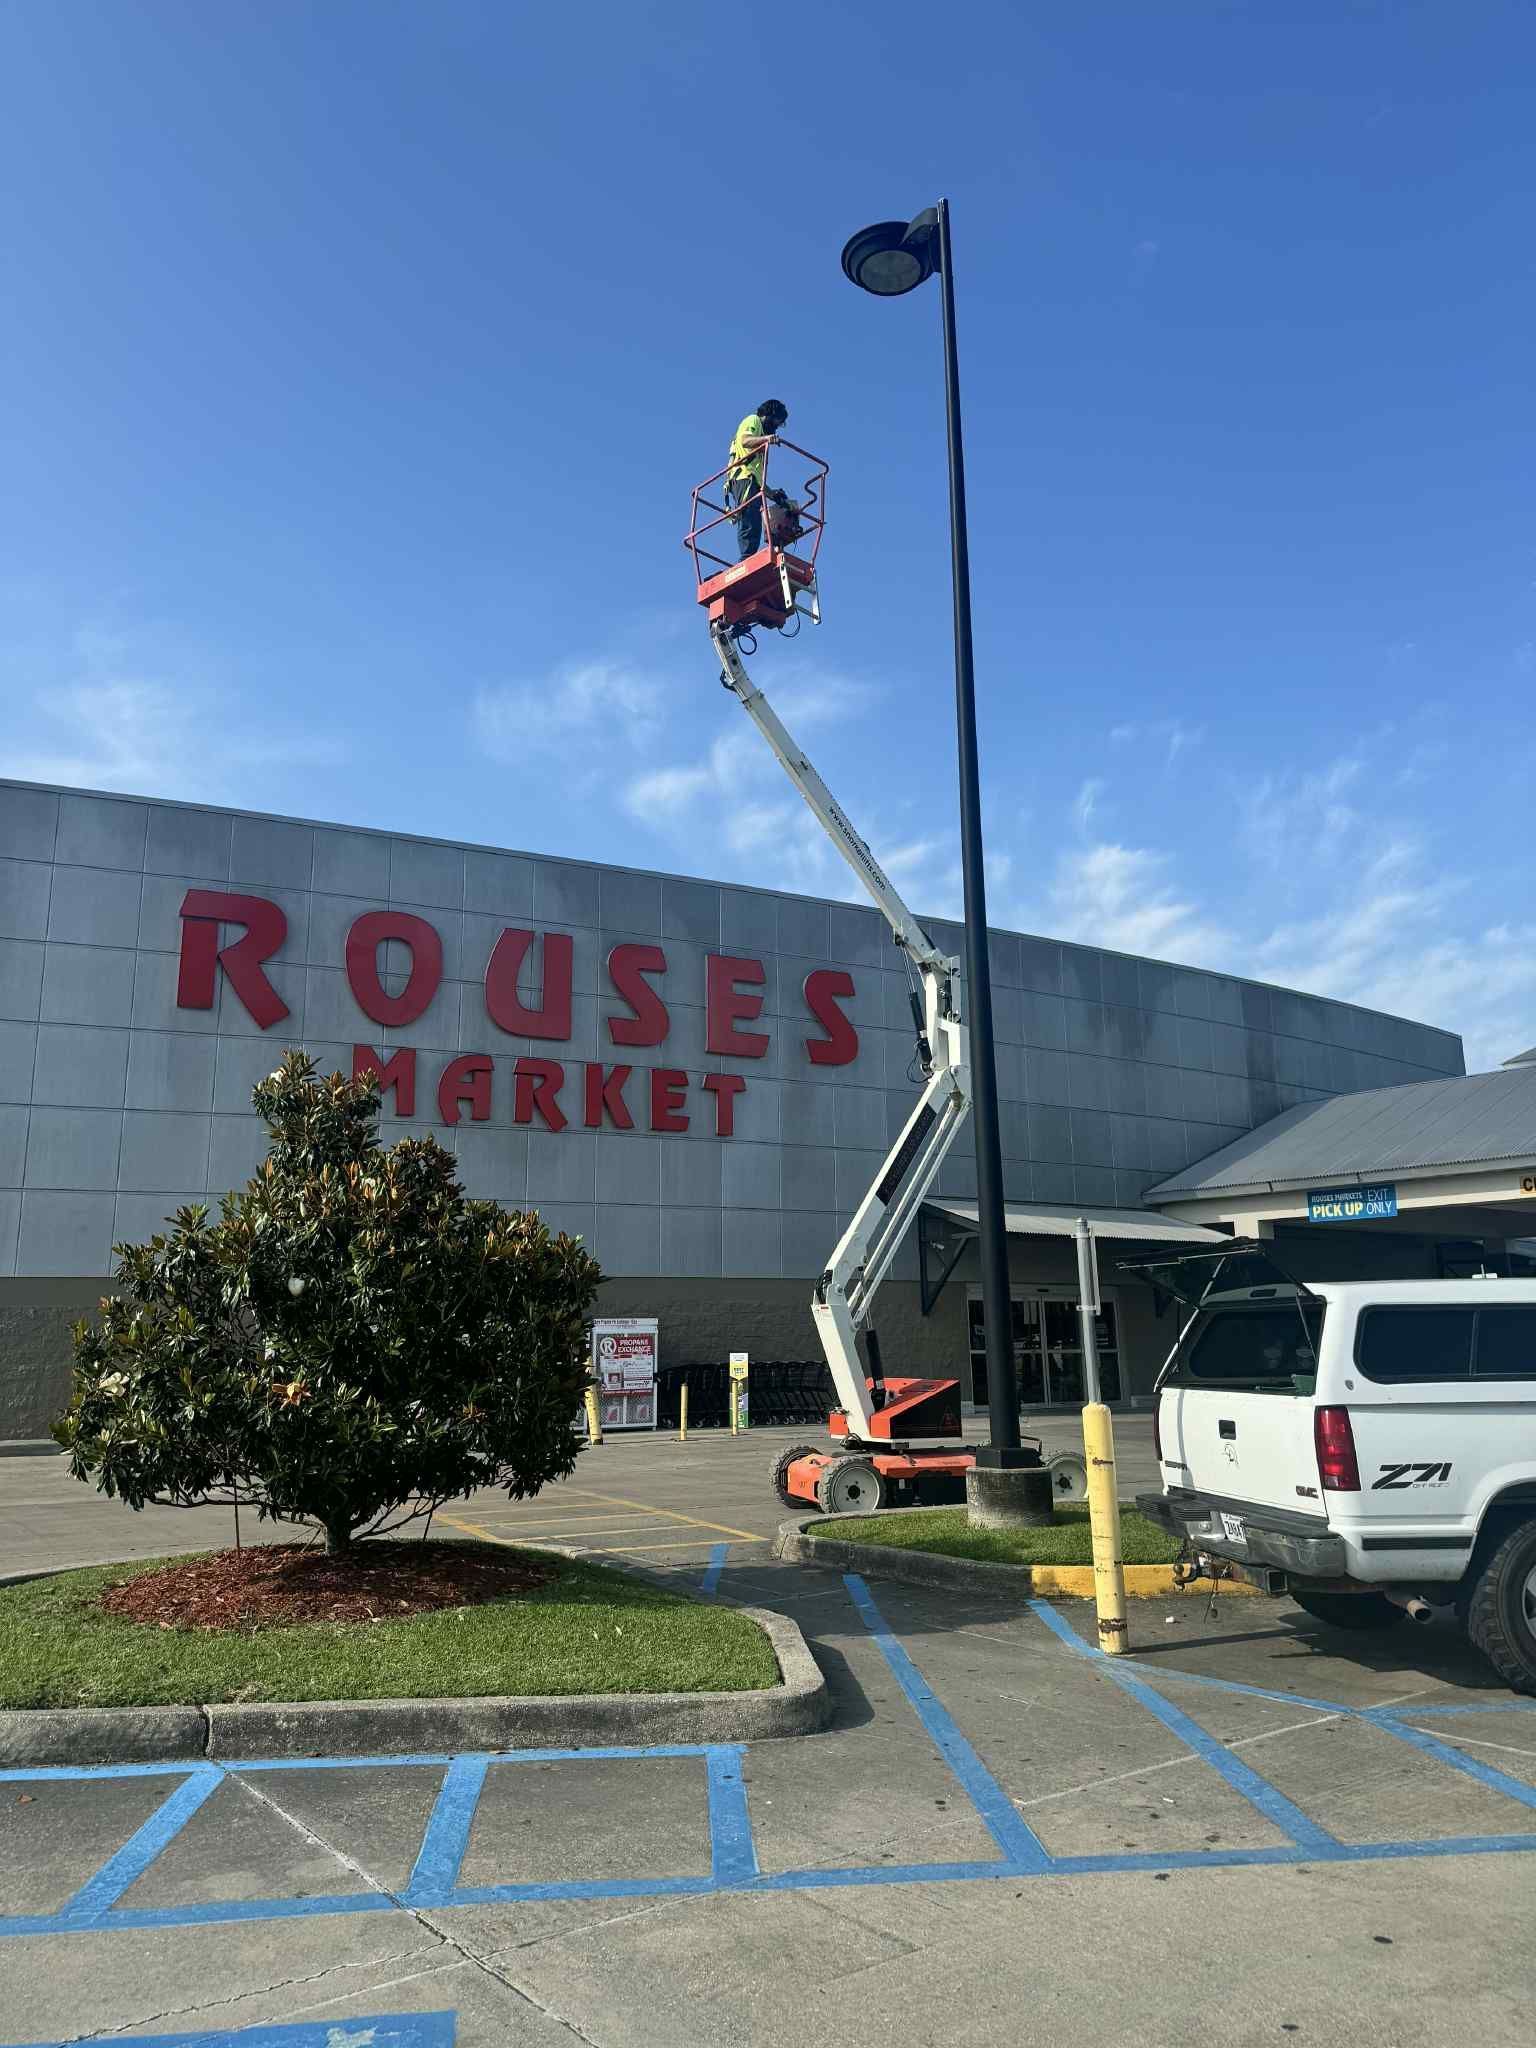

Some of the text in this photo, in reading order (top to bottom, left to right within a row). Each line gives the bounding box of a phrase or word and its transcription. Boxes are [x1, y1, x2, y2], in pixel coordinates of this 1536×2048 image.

[177, 888, 859, 1066] ROUSES
[352, 1043, 746, 1136] MARKET
[1367, 1188, 1388, 1201] EXIT
[1312, 1201, 1363, 1218] PICK UP
[1367, 1201, 1392, 1214] ONLY
[1371, 1462, 1453, 1489] Z71
[1296, 1486, 1319, 1499] GMC
